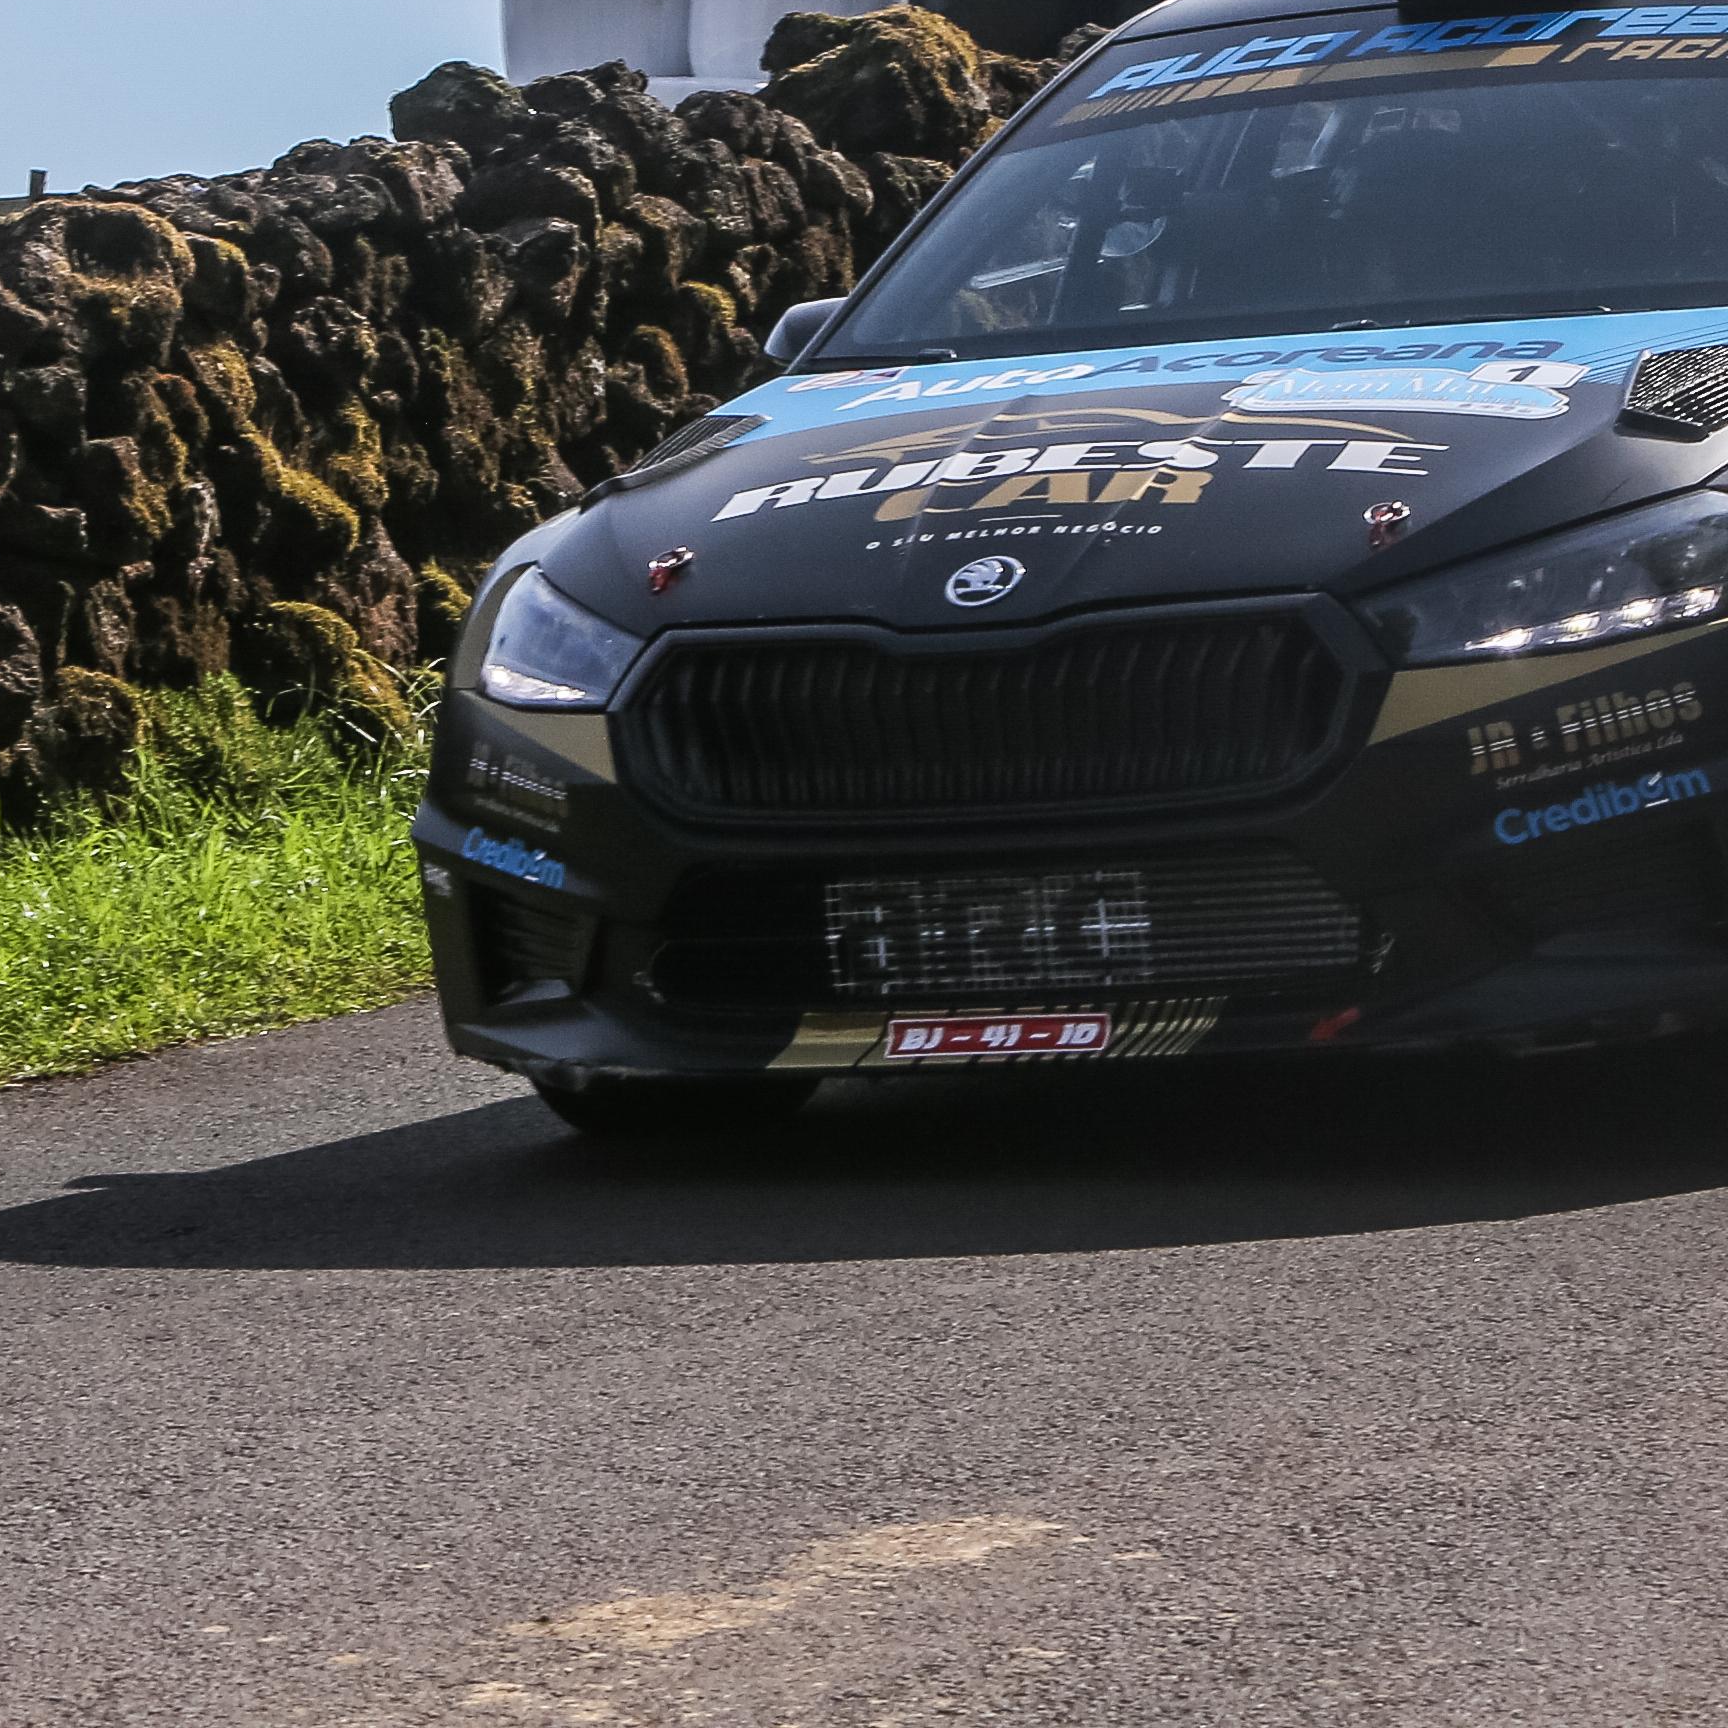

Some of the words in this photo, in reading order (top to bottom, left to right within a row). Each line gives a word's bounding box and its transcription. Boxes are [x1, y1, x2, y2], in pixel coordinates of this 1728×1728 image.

[1506, 364, 1541, 383] 1
[710, 436, 1450, 522] RUBESTE
[874, 467, 1213, 522] CAR
[865, 541, 881, 550] O
[944, 525, 1042, 541] MELHOR
[1556, 681, 1703, 752] Filhos
[1493, 767, 1712, 846] Credibom
